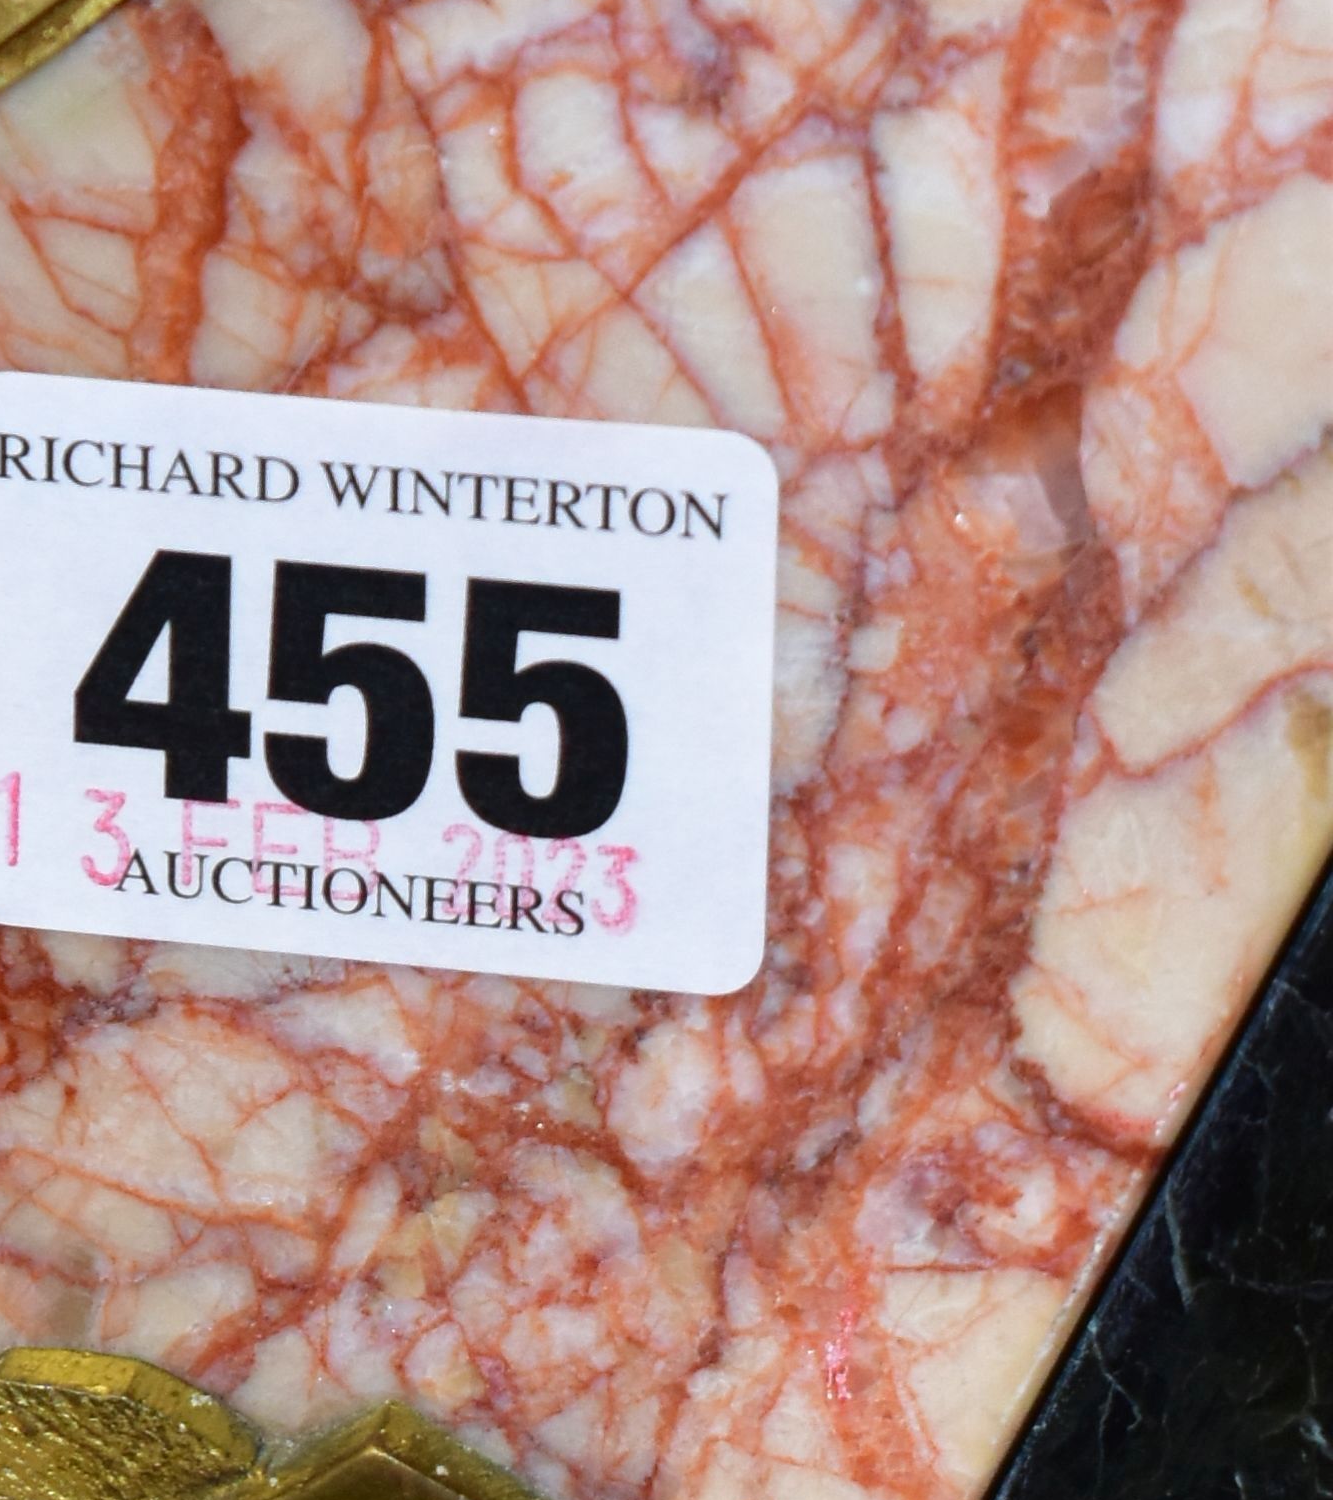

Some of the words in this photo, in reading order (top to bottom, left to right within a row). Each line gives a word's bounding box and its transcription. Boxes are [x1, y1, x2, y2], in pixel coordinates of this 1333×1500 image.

[320, 460, 731, 541] WINTERTON
[73, 548, 629, 841] 455
[113, 847, 585, 936] AUCTIONEERS
[442, 823, 639, 935] 2023
